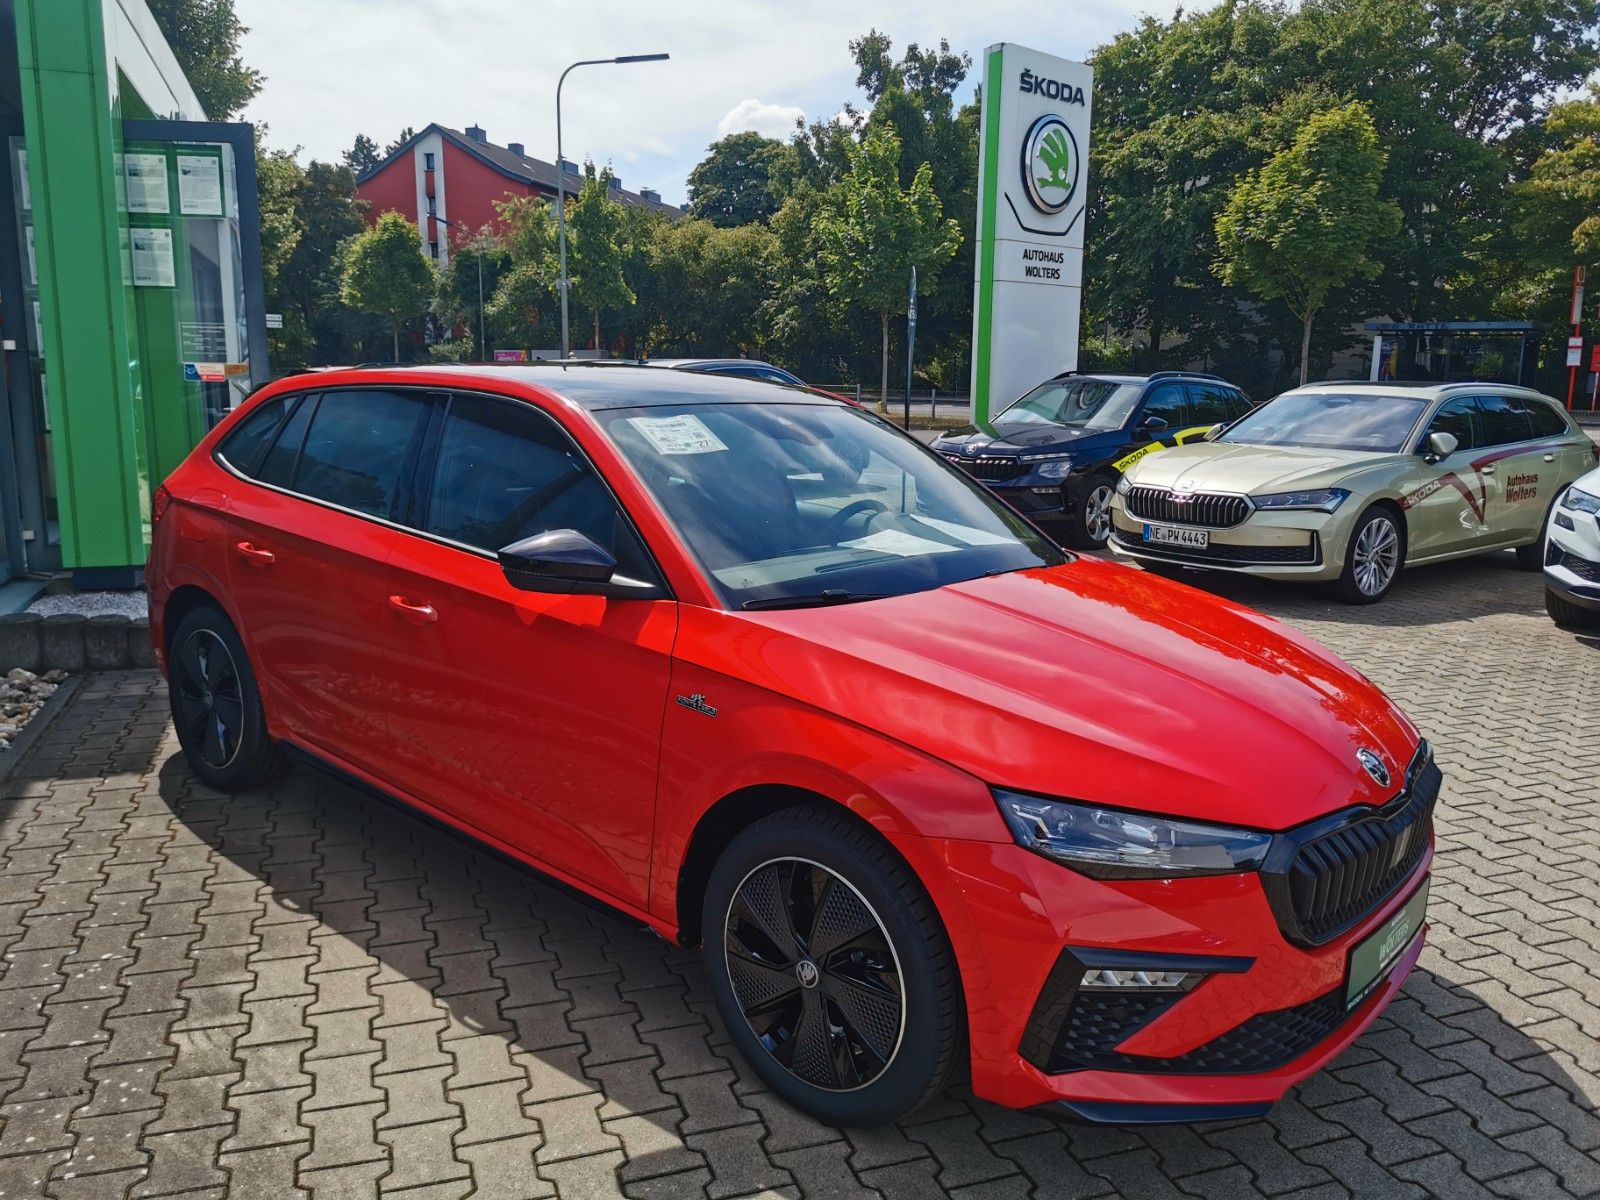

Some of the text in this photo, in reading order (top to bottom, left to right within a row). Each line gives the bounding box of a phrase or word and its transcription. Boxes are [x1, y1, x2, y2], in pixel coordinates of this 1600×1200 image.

[1019, 68, 1085, 107] ŠKODA
[1022, 248, 1064, 264] AUTOHAUS
[1025, 266, 1060, 280] WOLTERS
[1507, 473, 1539, 487] Autohaus
[1506, 486, 1537, 503] Wolters
[1150, 527, 1161, 540] NE
[1181, 531, 1206, 546] 4443
